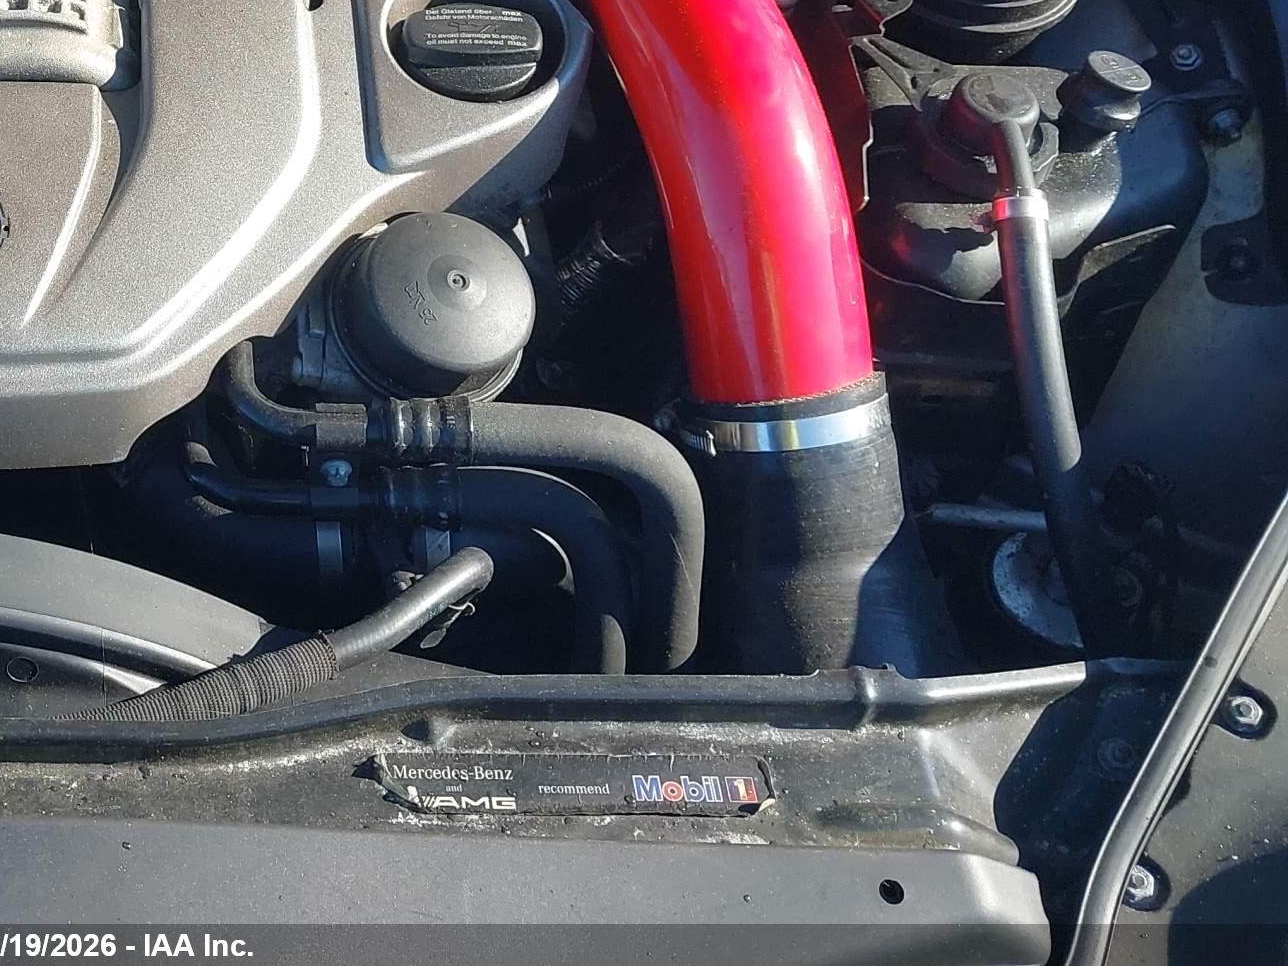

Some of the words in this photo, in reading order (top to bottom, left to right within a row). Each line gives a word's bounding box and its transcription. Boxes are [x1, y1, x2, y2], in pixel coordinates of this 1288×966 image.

[460, 32, 491, 40] damage
[392, 764, 513, 781] Mercedes-Benz
[445, 784, 463, 792] and
[538, 783, 611, 795] recommend
[631, 774, 722, 804] Mobil
[432, 795, 517, 810] AMG
